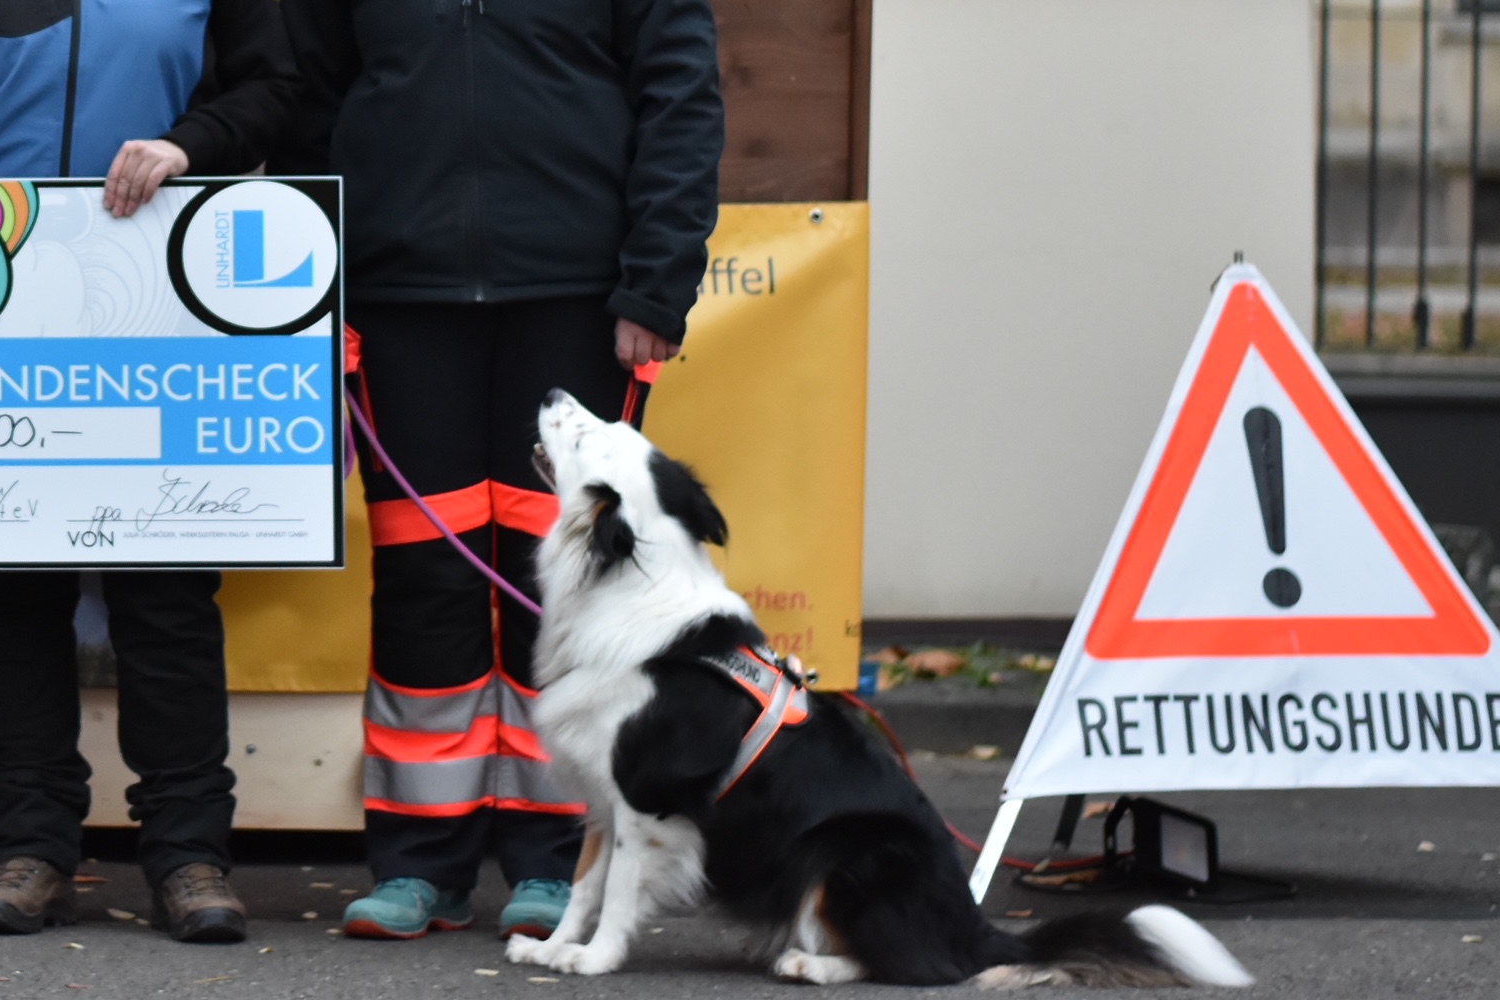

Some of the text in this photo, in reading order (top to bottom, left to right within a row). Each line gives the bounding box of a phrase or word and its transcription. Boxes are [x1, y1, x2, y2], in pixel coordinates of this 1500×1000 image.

[215, 210, 230, 288] LINHARDT
[700, 257, 776, 296] ffel
[196, 415, 326, 454] EURO
[66, 530, 115, 548] VON
[1077, 692, 1500, 757] RETTUNGSHUNDE
